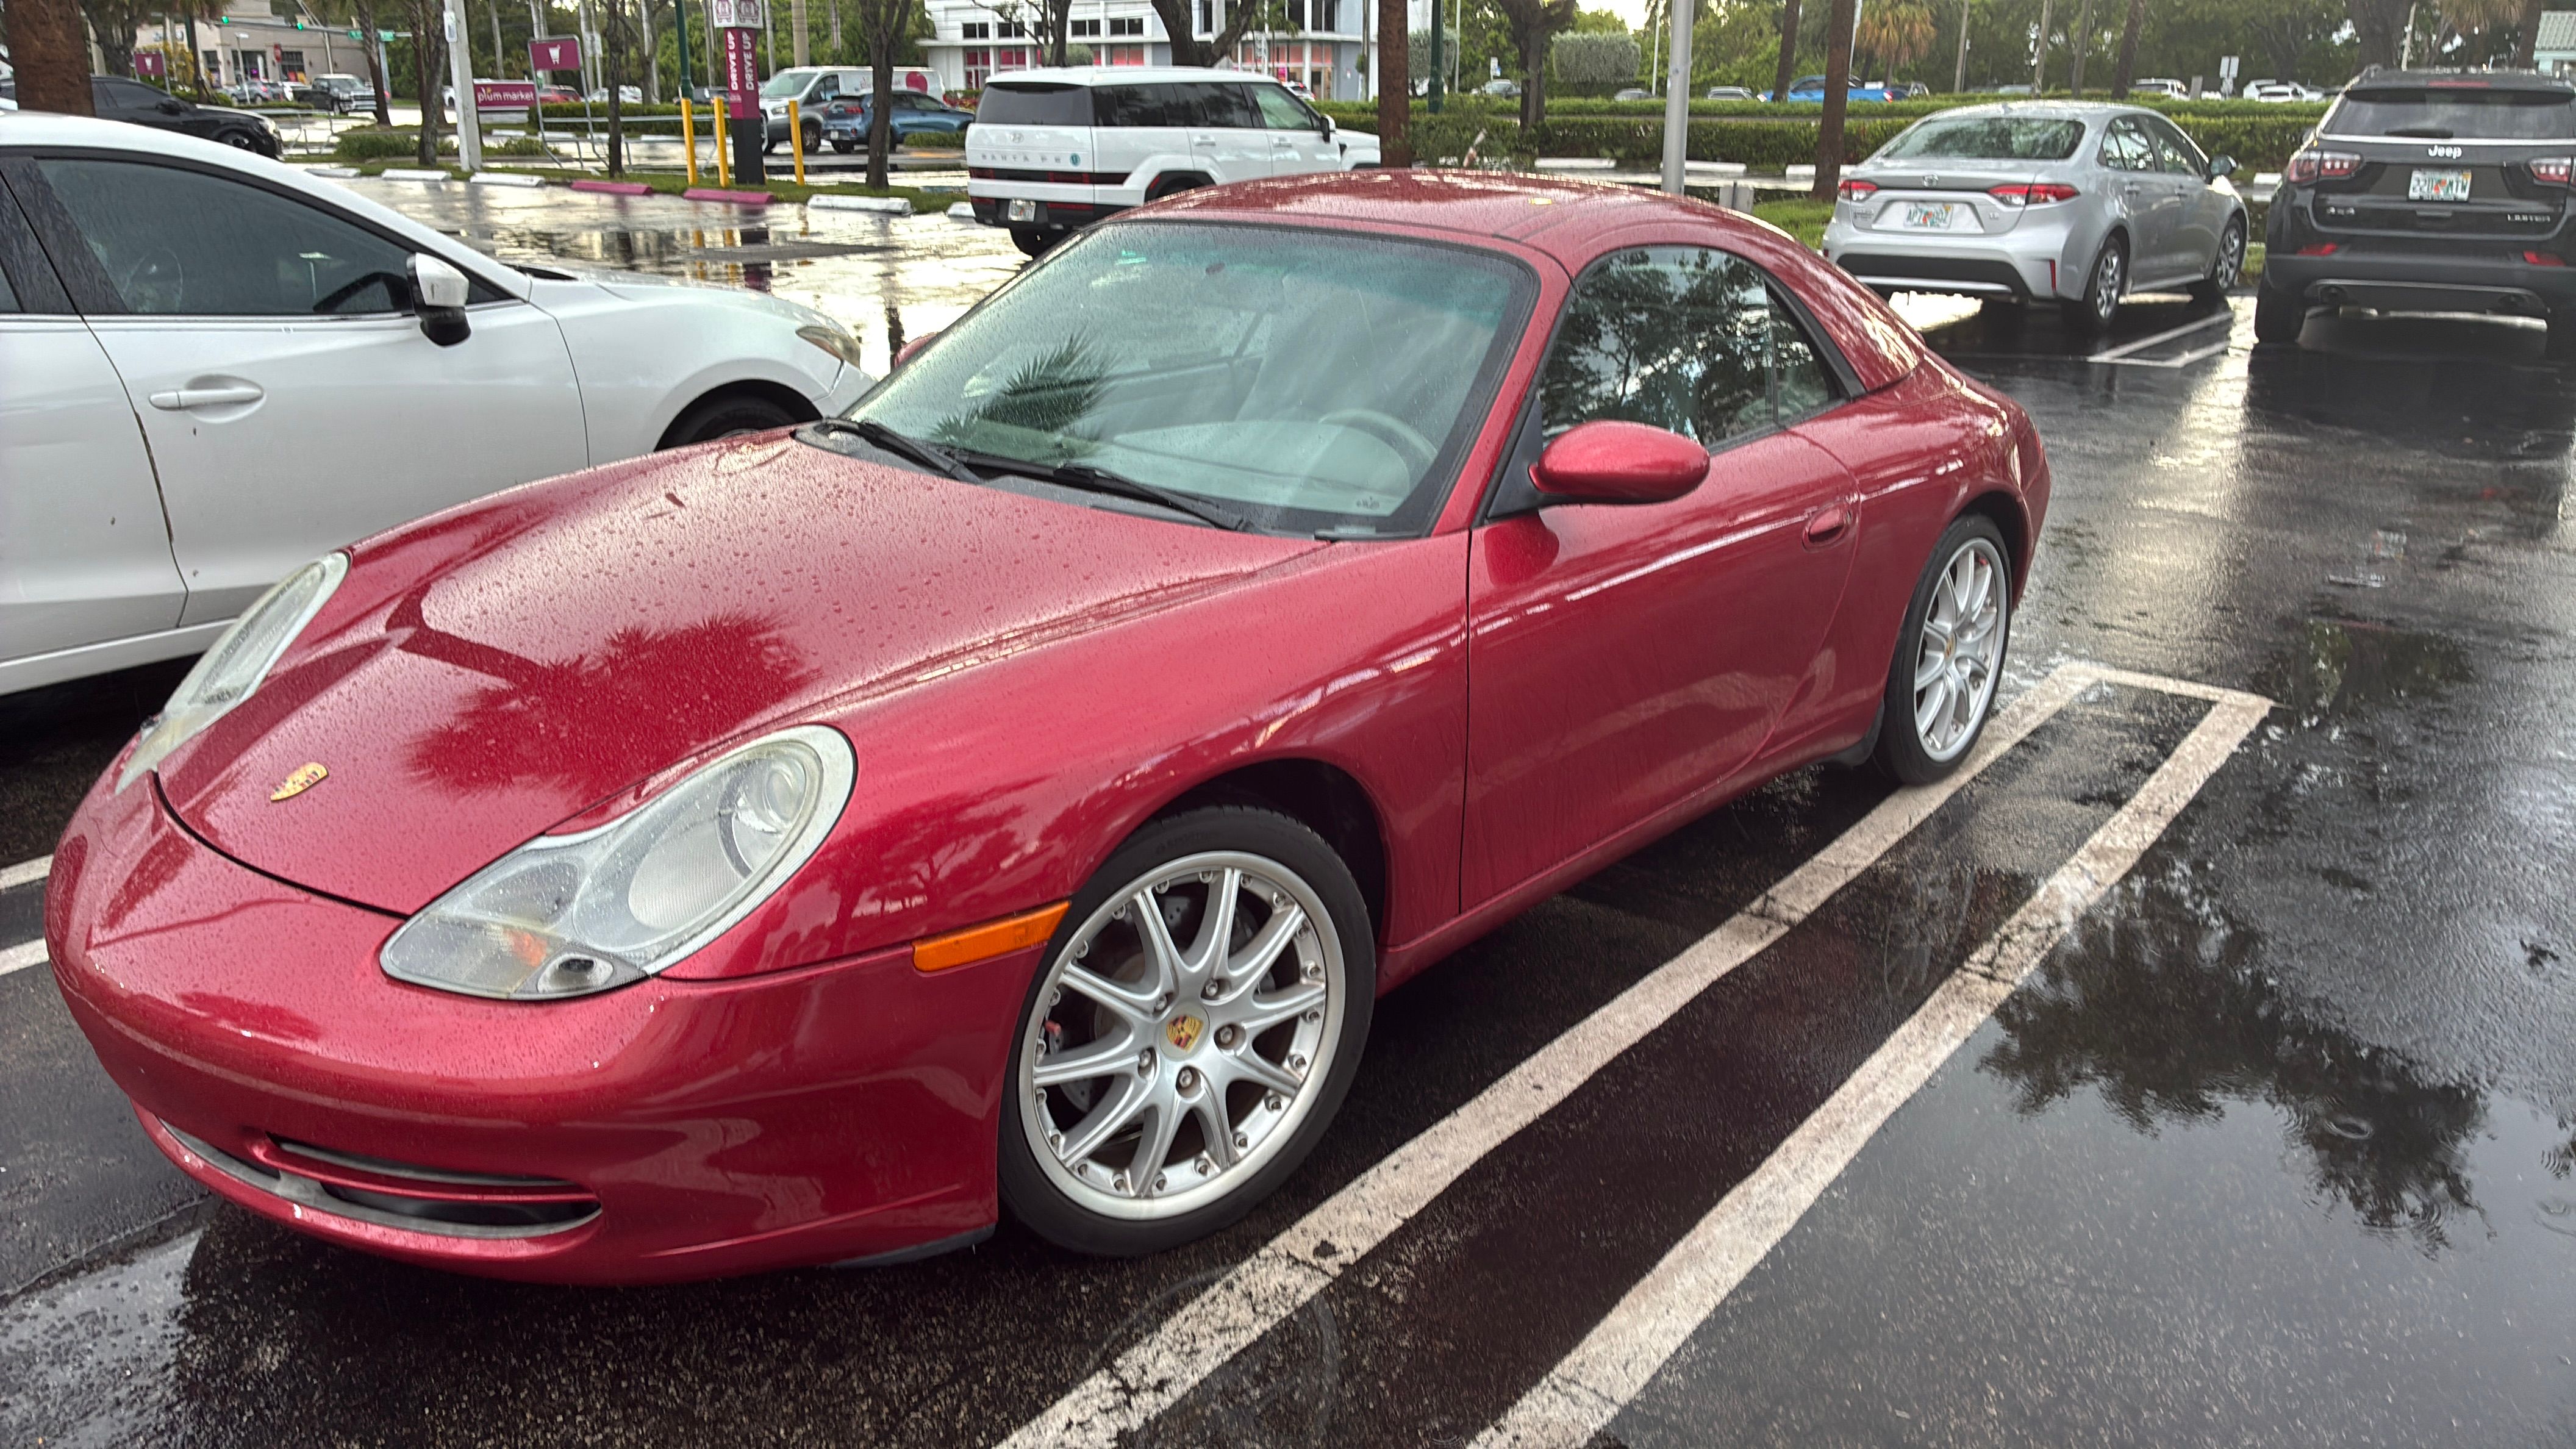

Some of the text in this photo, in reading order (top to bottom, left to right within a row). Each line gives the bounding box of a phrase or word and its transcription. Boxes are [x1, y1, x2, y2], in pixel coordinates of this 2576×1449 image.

[727, 31, 735, 50] UP
[742, 31, 755, 91] DRIVE UP
[728, 52, 739, 91] DRIVE
[477, 87, 534, 104] plum market
[2428, 145, 2462, 159] Jeep
